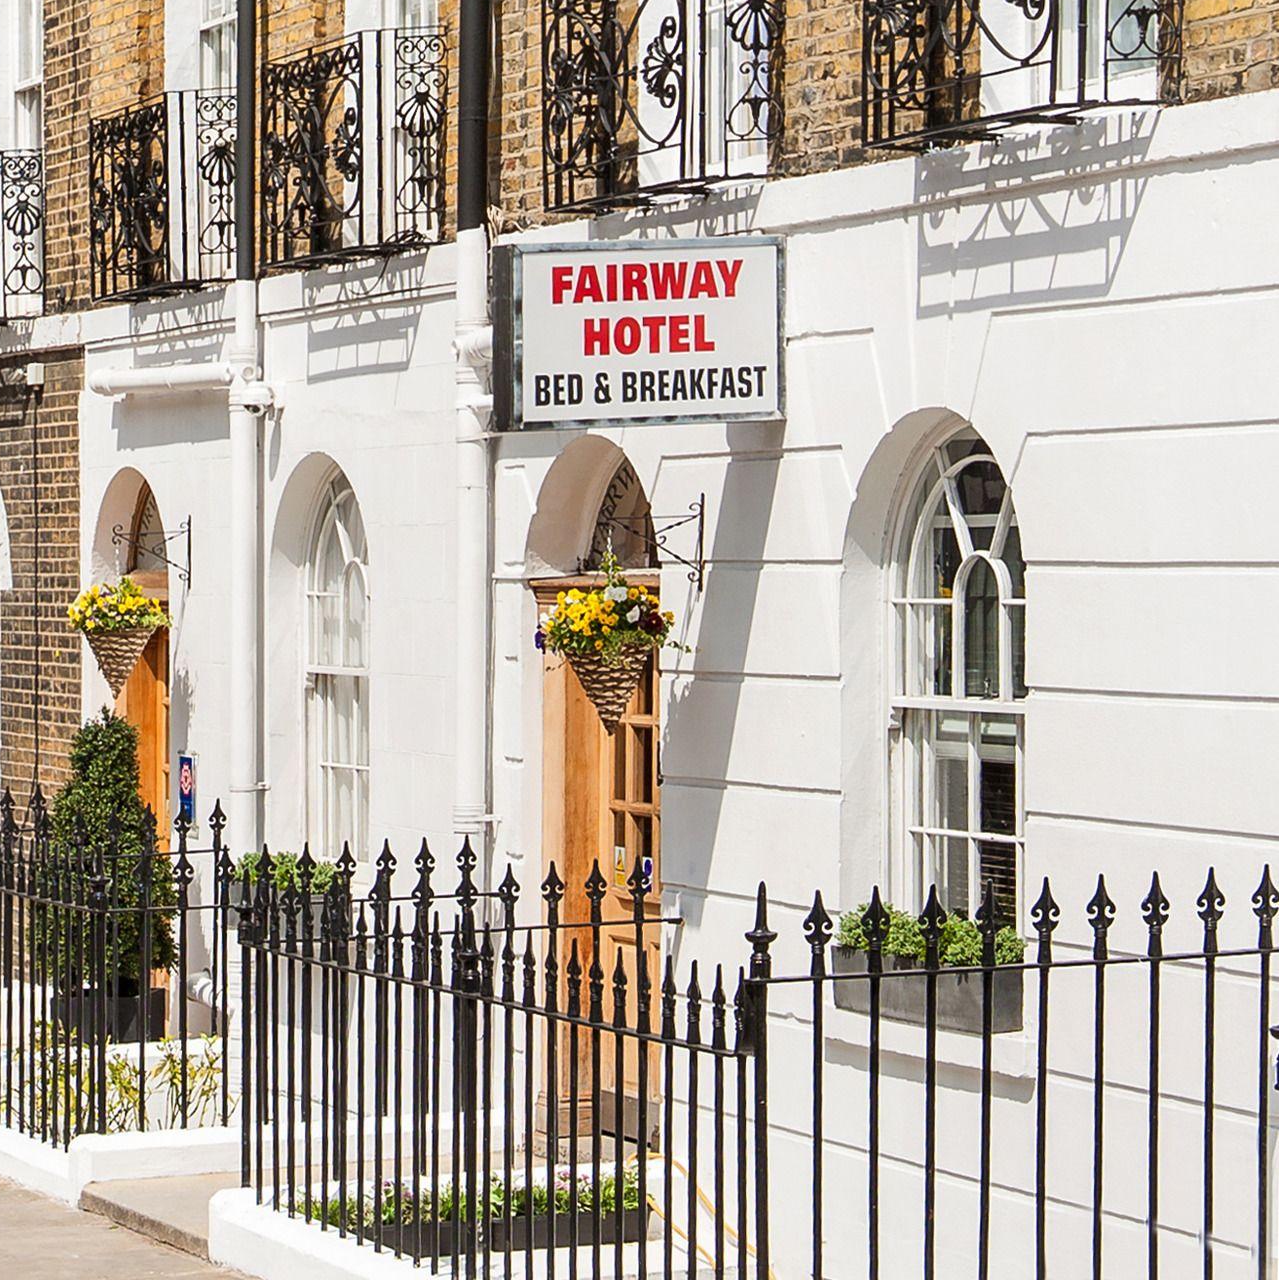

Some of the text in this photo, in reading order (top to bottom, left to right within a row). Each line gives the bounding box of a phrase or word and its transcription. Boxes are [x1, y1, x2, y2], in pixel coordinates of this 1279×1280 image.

[551, 259, 744, 305] FAIRWAY
[583, 313, 716, 357] HOTEL
[534, 365, 768, 407] BED & BREAKFAST
